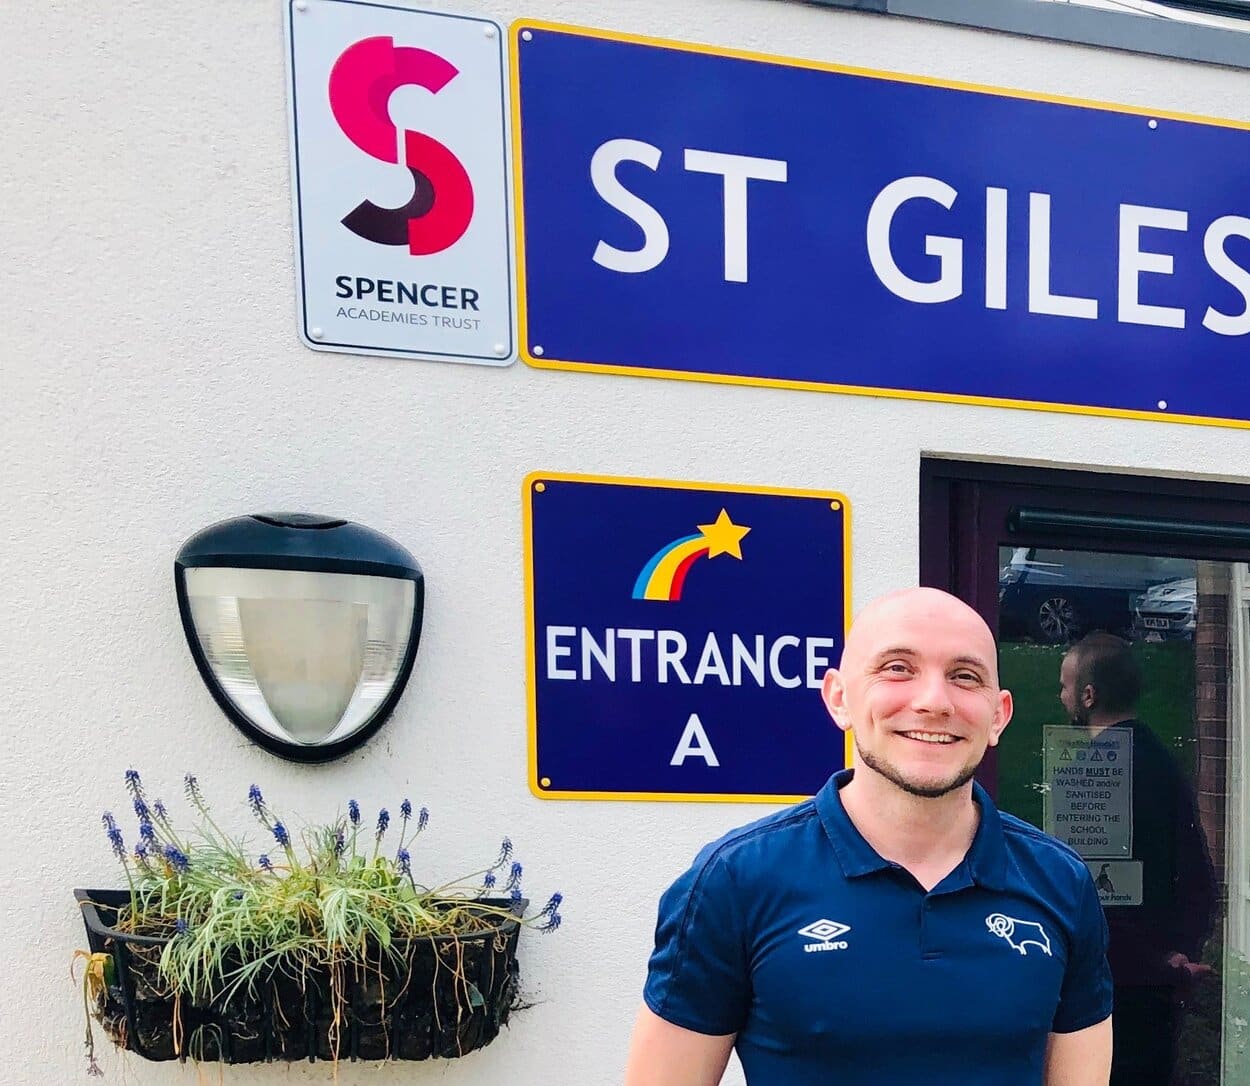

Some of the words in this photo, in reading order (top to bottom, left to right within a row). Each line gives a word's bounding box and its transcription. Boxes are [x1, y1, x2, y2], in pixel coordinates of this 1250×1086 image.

[590, 138, 788, 283] ST
[335, 275, 480, 311] SPENCER
[336, 306, 428, 326] ACADEMIES
[432, 315, 481, 331] TRUST
[546, 625, 834, 690] ENTRANCE
[669, 713, 720, 767] A
[1053, 766, 1083, 775] HANDS
[1086, 768, 1110, 777] MUST
[1056, 778, 1094, 787] WASHED
[1066, 791, 1111, 799] SANITISED
[1071, 803, 1106, 811] BEFORE
[1057, 814, 1101, 822] ENTERING
[1071, 826, 1107, 834] SCHOOL
[1068, 838, 1108, 846] BUILDING
[803, 940, 848, 953] umbro
